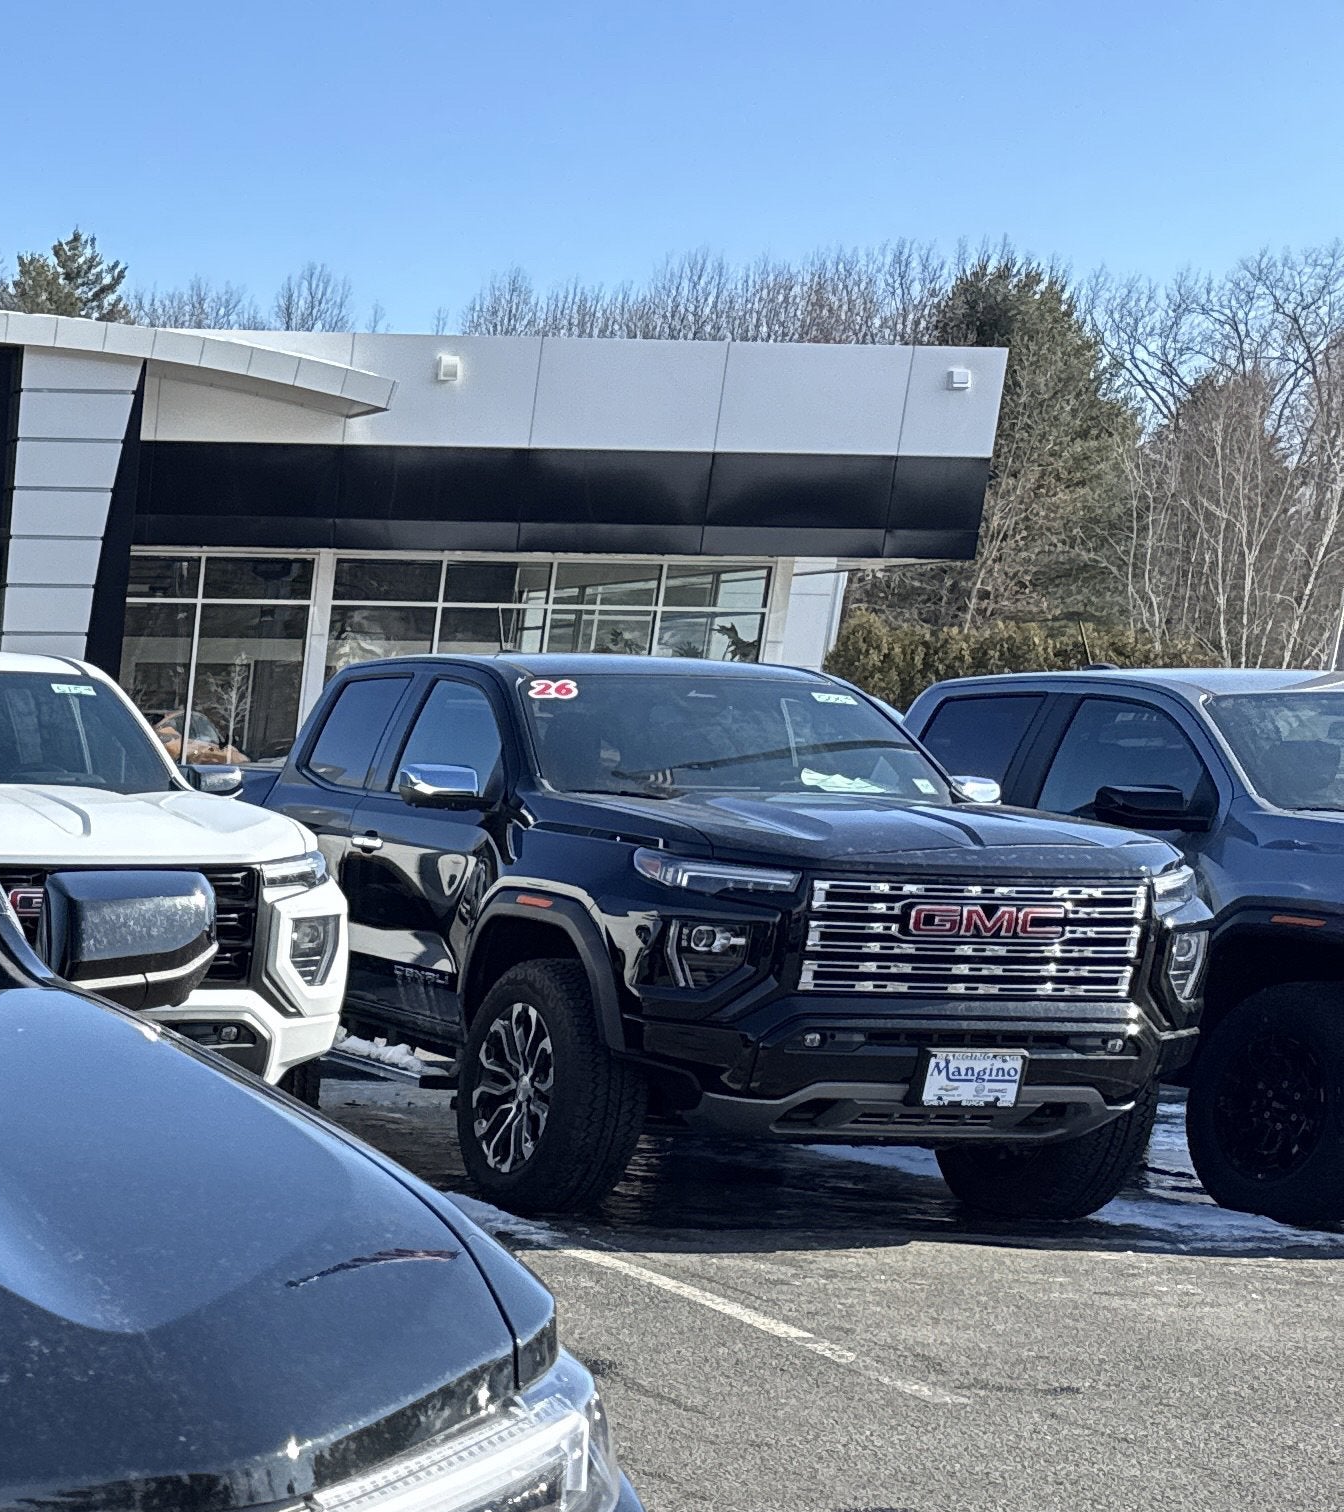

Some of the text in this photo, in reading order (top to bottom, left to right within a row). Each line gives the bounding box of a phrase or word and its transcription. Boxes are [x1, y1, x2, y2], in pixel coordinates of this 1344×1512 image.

[530, 681, 576, 698] 26
[909, 904, 1065, 938] GMC
[929, 1061, 1018, 1083] Mangino
